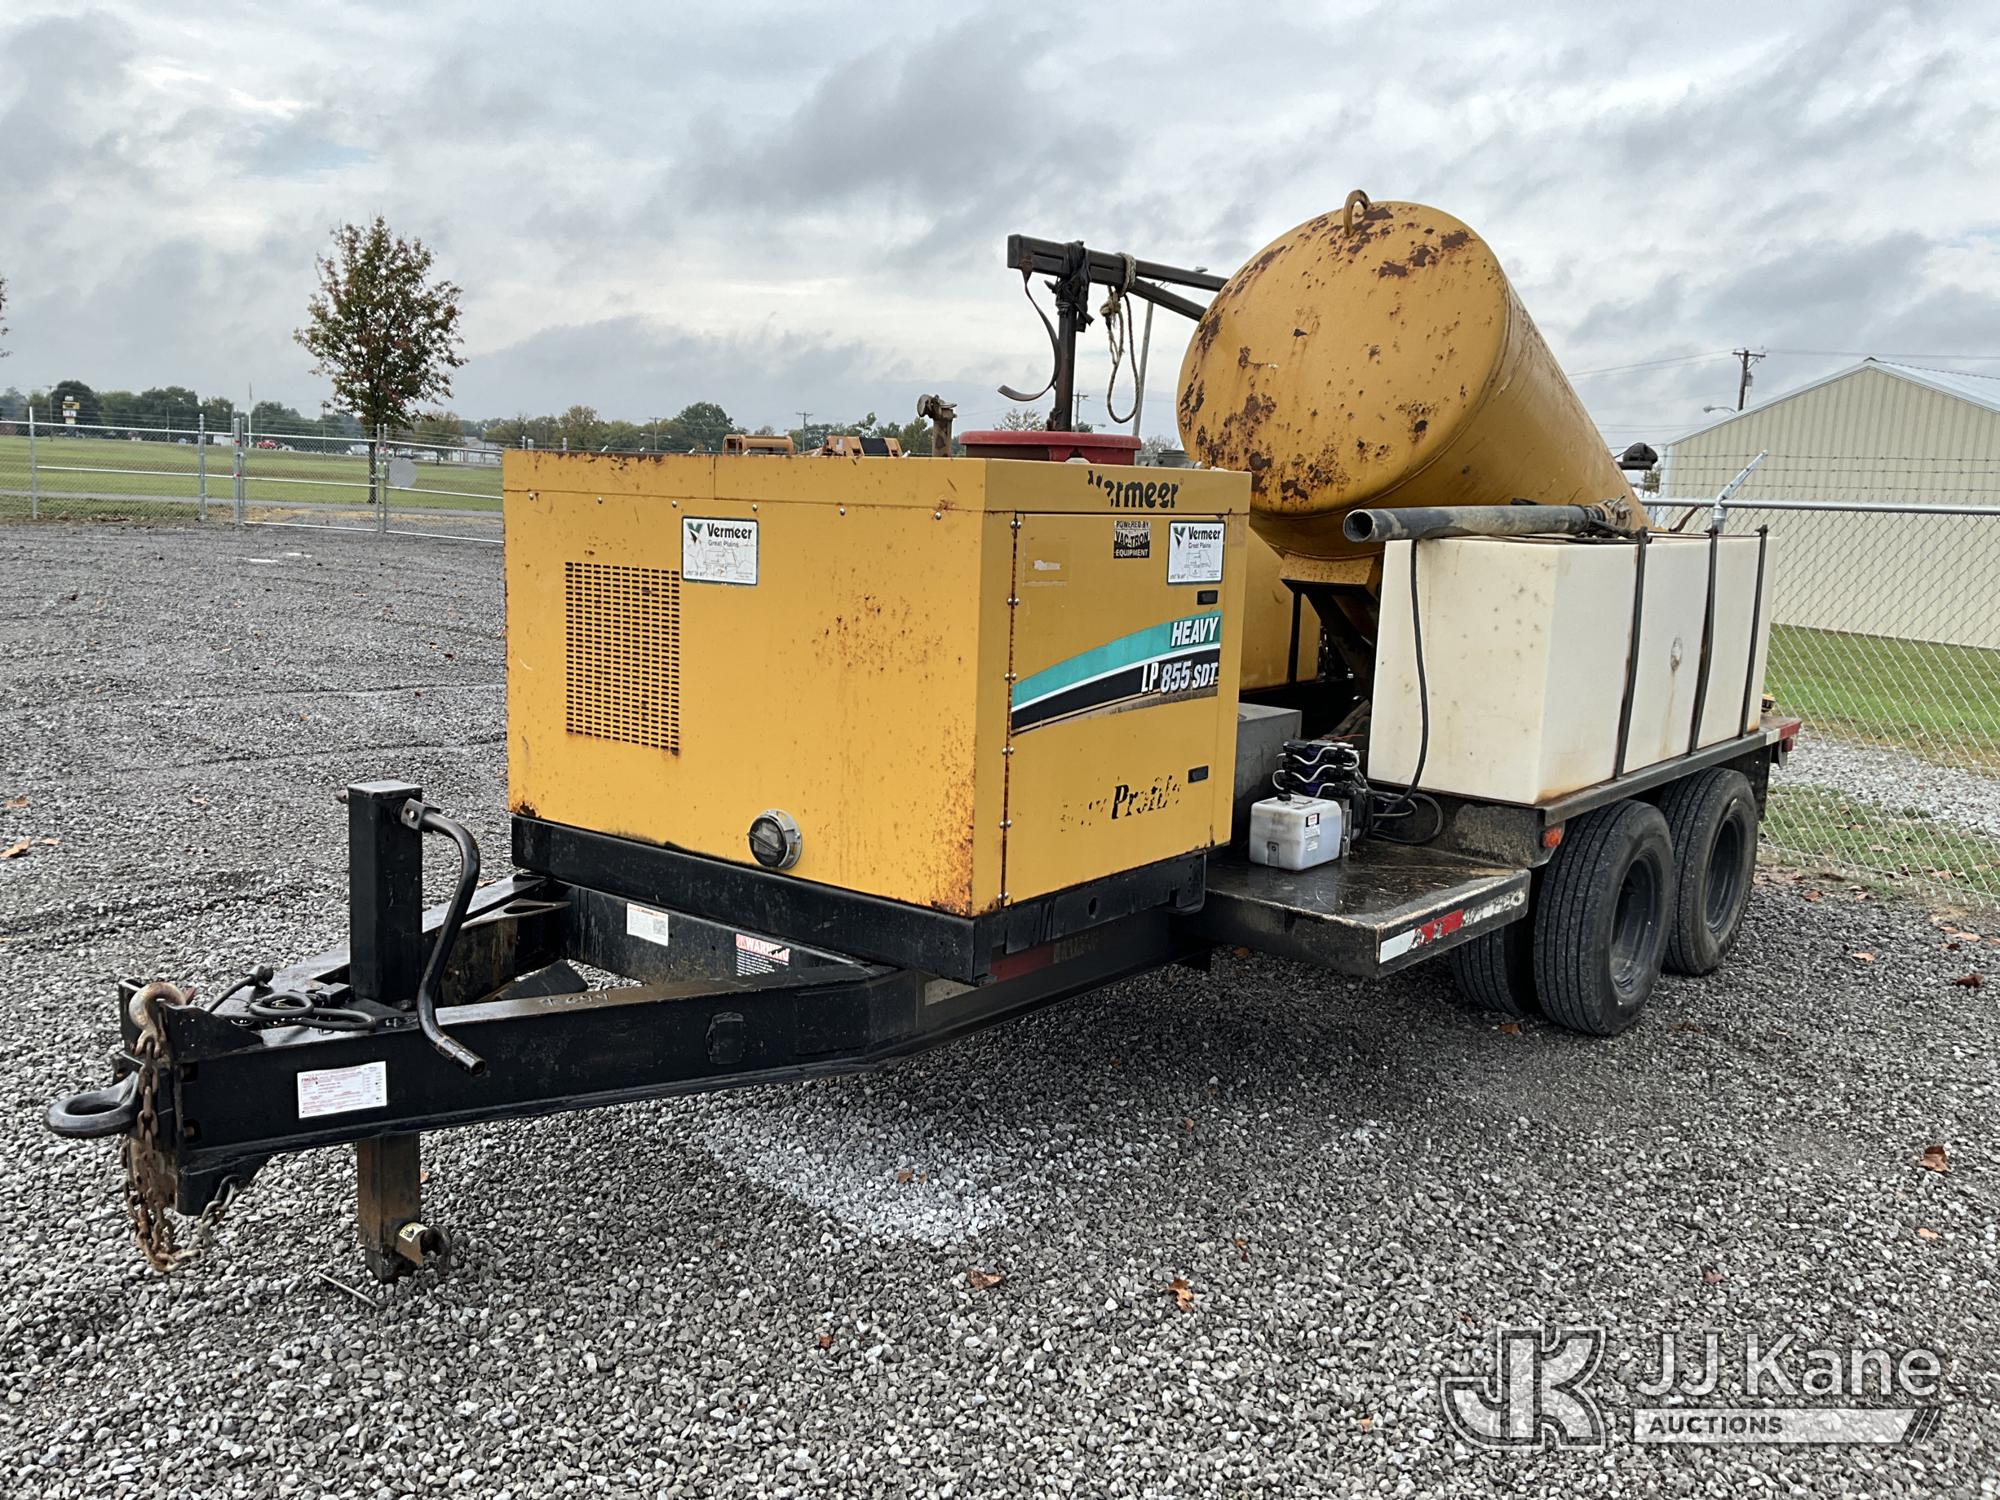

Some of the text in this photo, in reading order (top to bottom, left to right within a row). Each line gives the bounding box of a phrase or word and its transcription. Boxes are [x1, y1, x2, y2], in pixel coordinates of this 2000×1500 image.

[707, 523, 752, 540] Vermeer
[1116, 520, 1141, 528] POWERED
[1188, 526, 1221, 540] Vermeer
[1115, 549, 1149, 557] EQUIPMENT
[1171, 616, 1219, 648] HEAVY
[1141, 659, 1219, 694] LP 855 SDT
